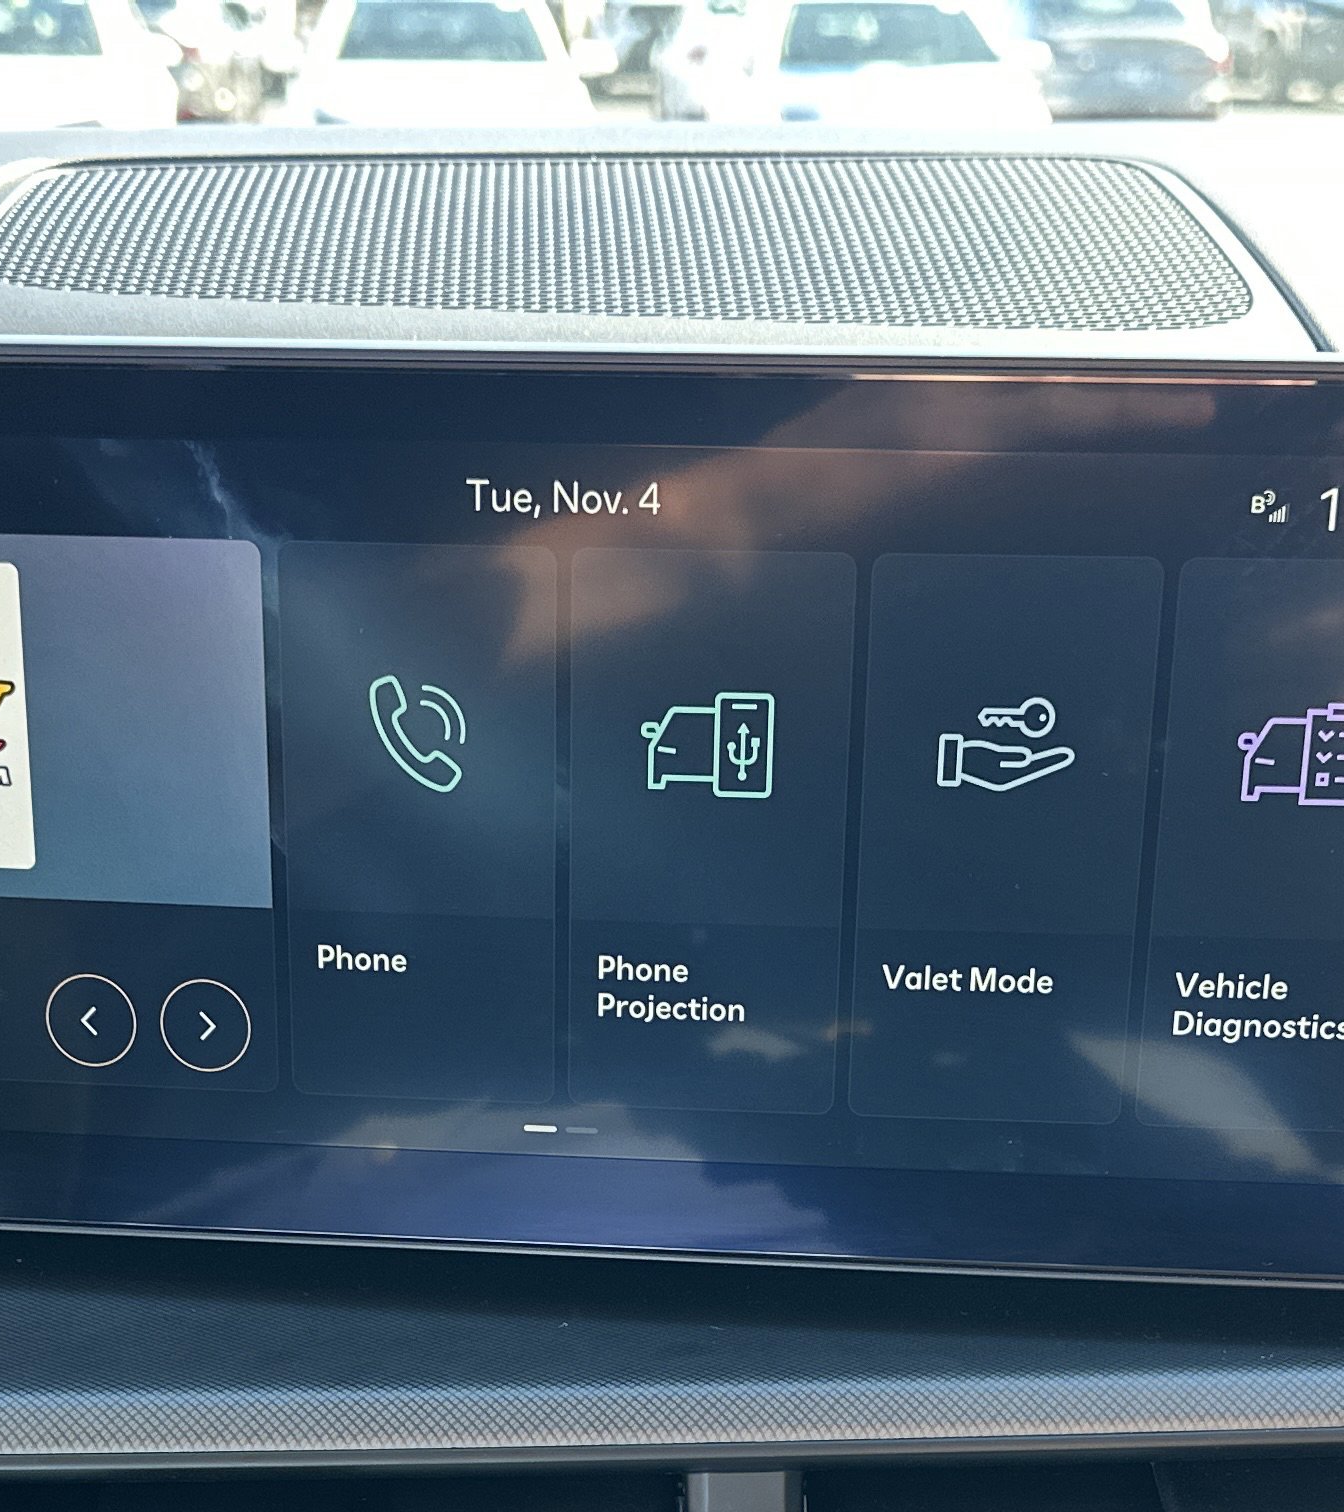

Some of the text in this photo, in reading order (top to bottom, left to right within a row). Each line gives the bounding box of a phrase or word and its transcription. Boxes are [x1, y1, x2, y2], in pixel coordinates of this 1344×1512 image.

[465, 478, 661, 519] Tue, Nov. 4
[317, 944, 407, 973] Phone
[598, 954, 689, 983] Phone
[882, 963, 1054, 994] Valet Mode
[1175, 971, 1288, 1001] Vehicle
[597, 992, 745, 1023] Projection
